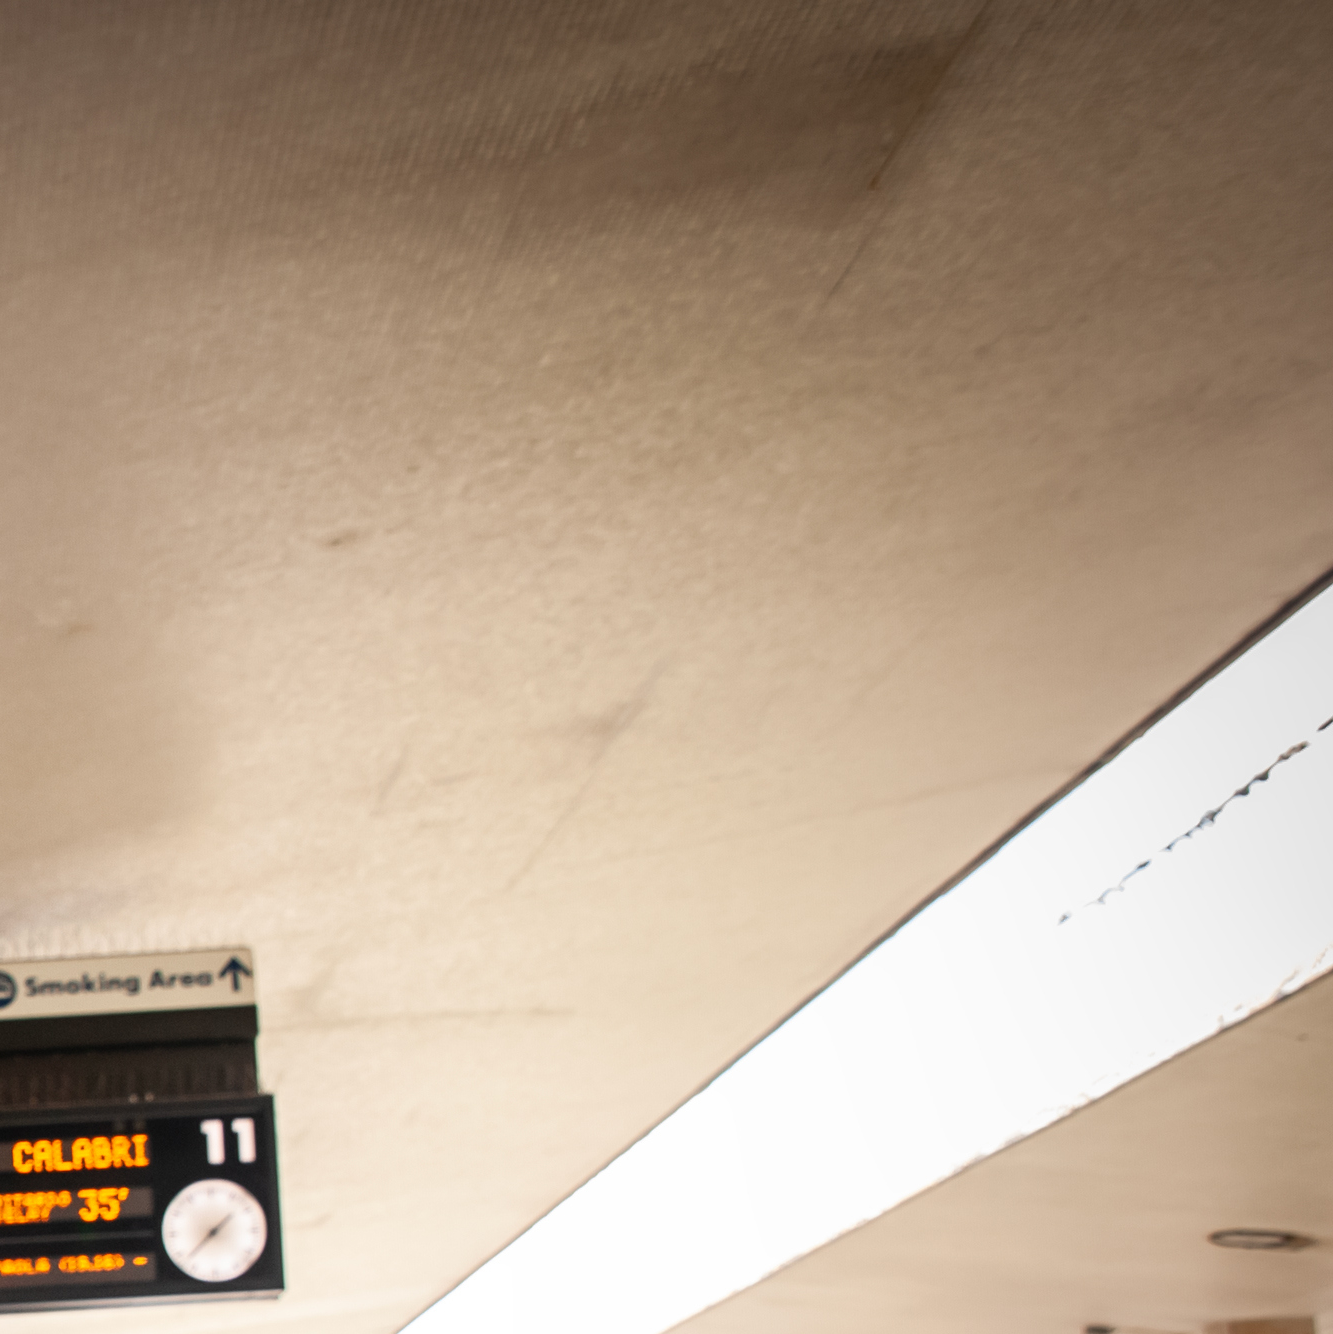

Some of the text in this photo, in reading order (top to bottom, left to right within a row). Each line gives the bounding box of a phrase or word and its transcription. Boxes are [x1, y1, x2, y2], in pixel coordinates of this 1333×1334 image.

[25, 971, 139, 997] Smoking
[149, 968, 213, 990] Area
[12, 1134, 150, 1175] CALABRI
[199, 1117, 258, 1166] 11
